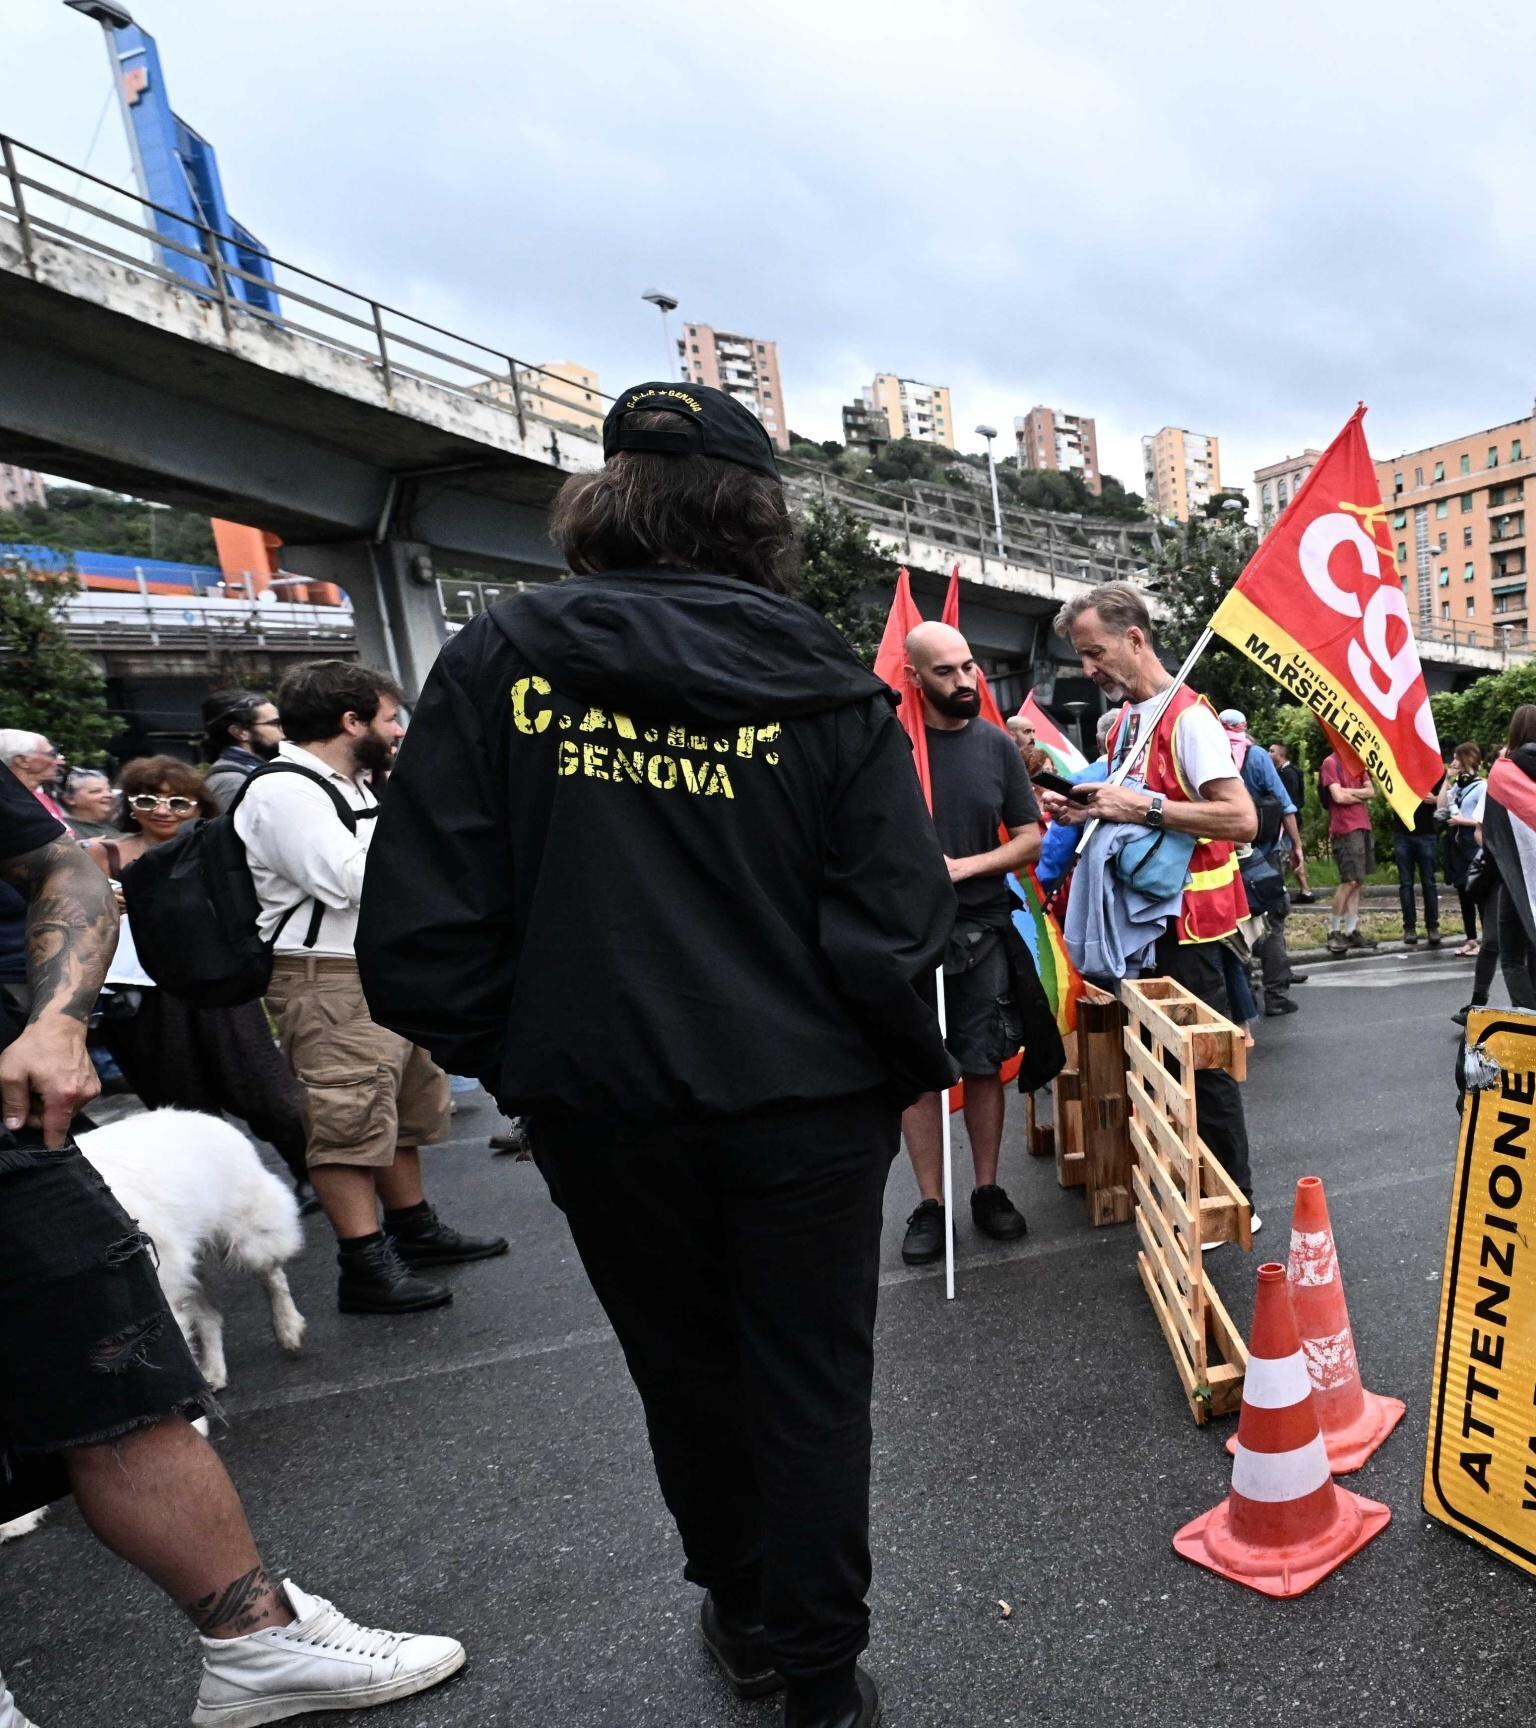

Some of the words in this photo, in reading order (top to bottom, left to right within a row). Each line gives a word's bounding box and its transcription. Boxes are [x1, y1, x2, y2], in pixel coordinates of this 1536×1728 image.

[668, 390, 702, 412] GENOVA
[1245, 633, 1366, 753] MARSEILLE
[1366, 750, 1394, 795] SUD
[1293, 655, 1338, 701] Union
[1341, 701, 1381, 751] Locale
[558, 740, 734, 799] GENOVA
[1459, 1069, 1536, 1494] ATTENZIONE
